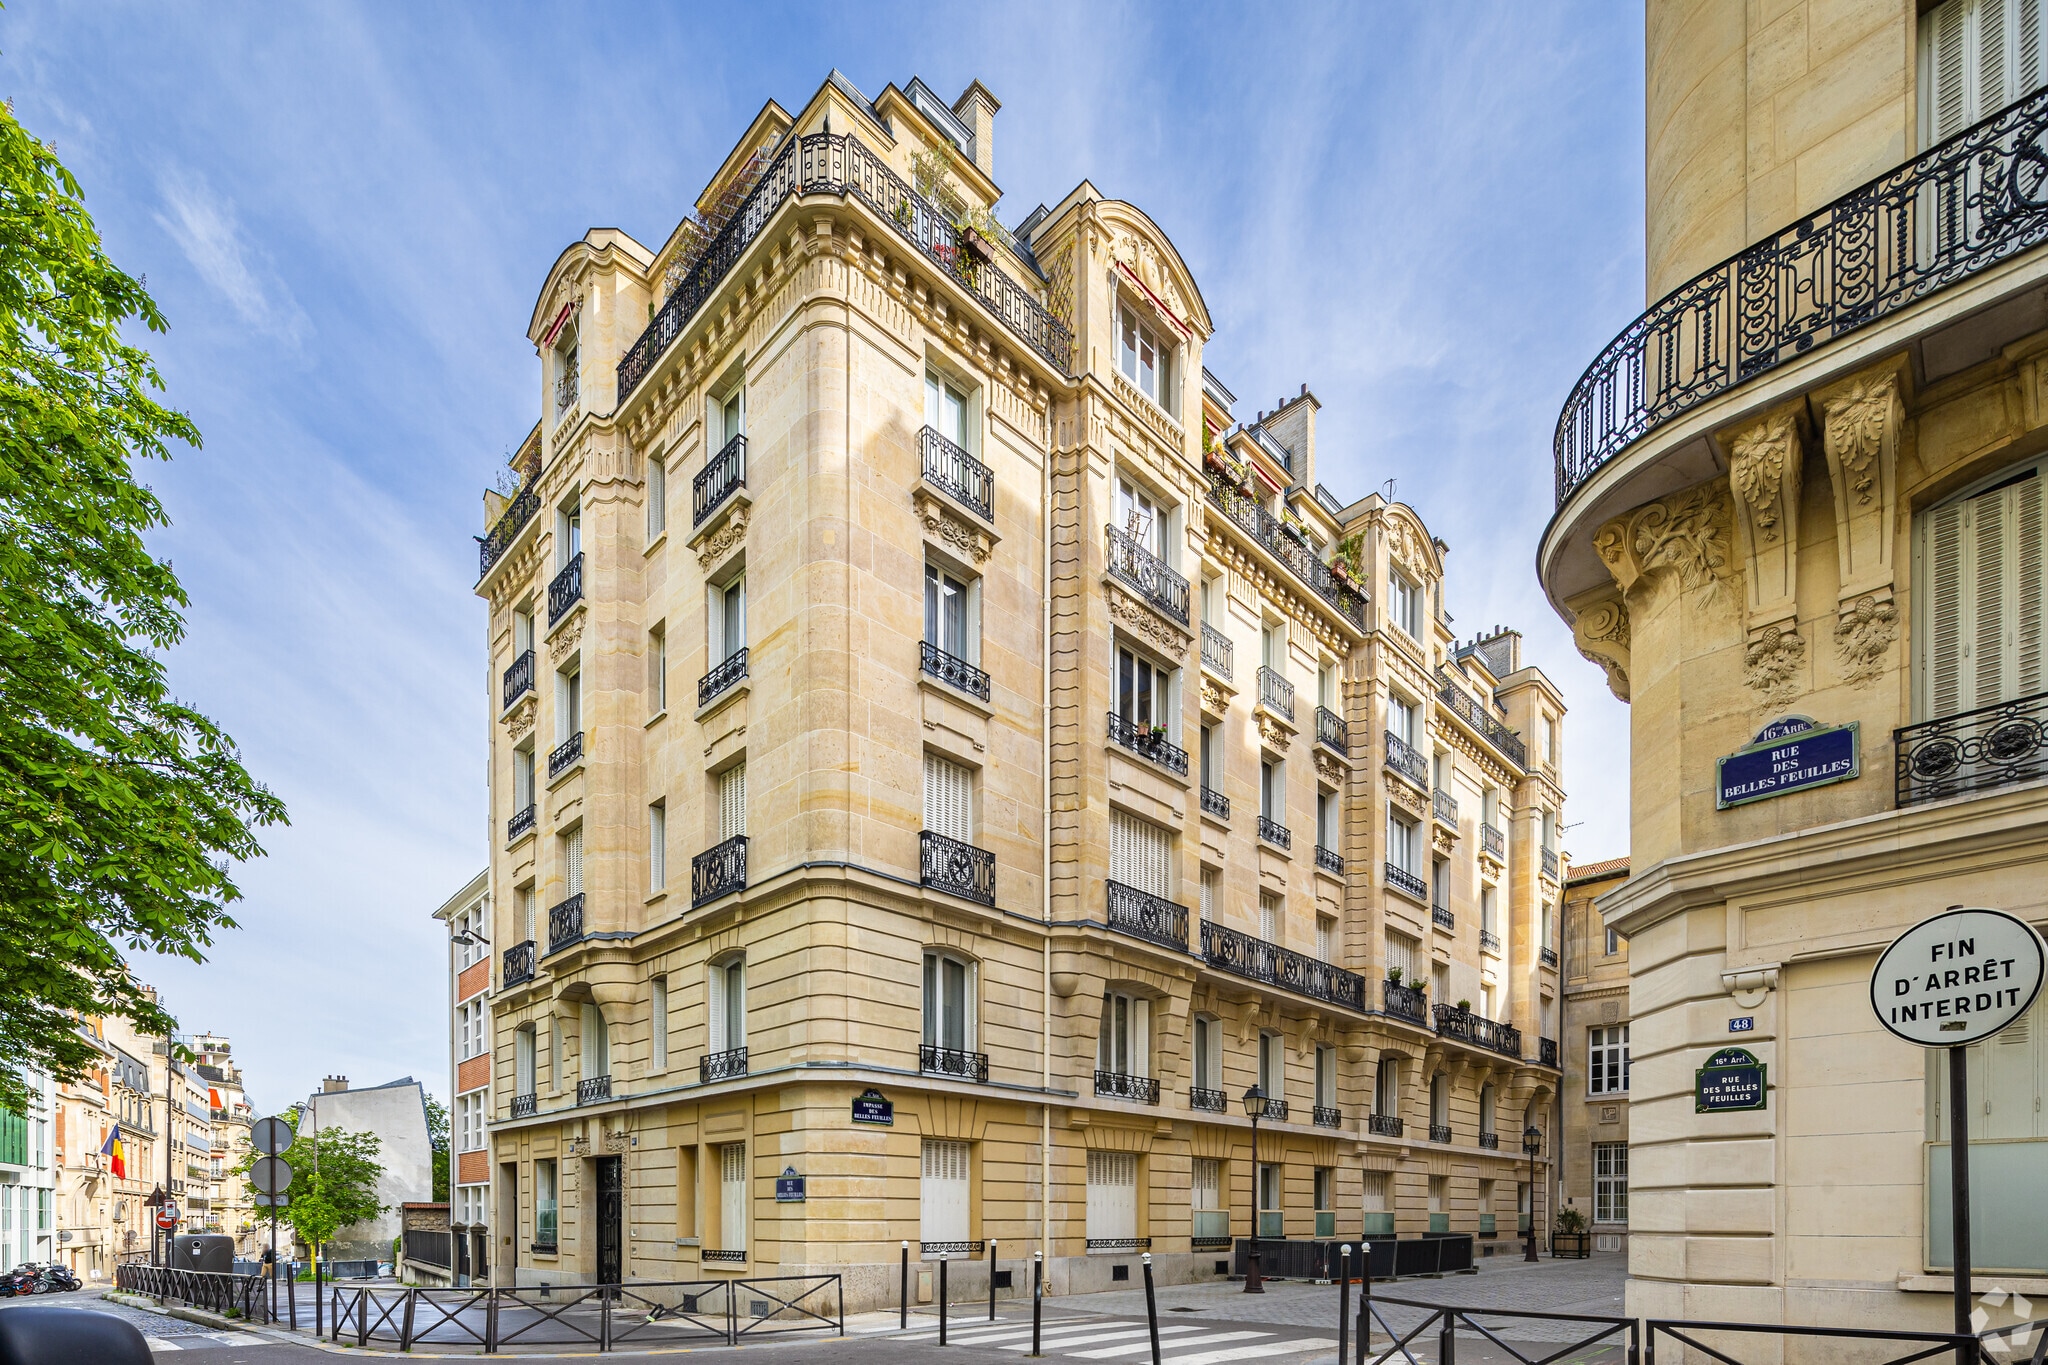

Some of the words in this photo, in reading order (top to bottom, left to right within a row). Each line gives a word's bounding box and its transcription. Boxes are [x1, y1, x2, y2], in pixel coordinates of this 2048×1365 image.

[1771, 745, 1800, 761] RUE
[1773, 758, 1799, 773] DES
[1725, 777, 1776, 798] BELLES
[1780, 758, 1851, 785] FEUILLES
[1931, 937, 1975, 963] FIN
[1891, 987, 2021, 1024] INTERDIT
[1733, 1019, 1748, 1030] 48
[1703, 1086, 1720, 1094] DES
[1725, 1083, 1758, 1092] BELLES
[1710, 1093, 1751, 1102] FEUILLES
